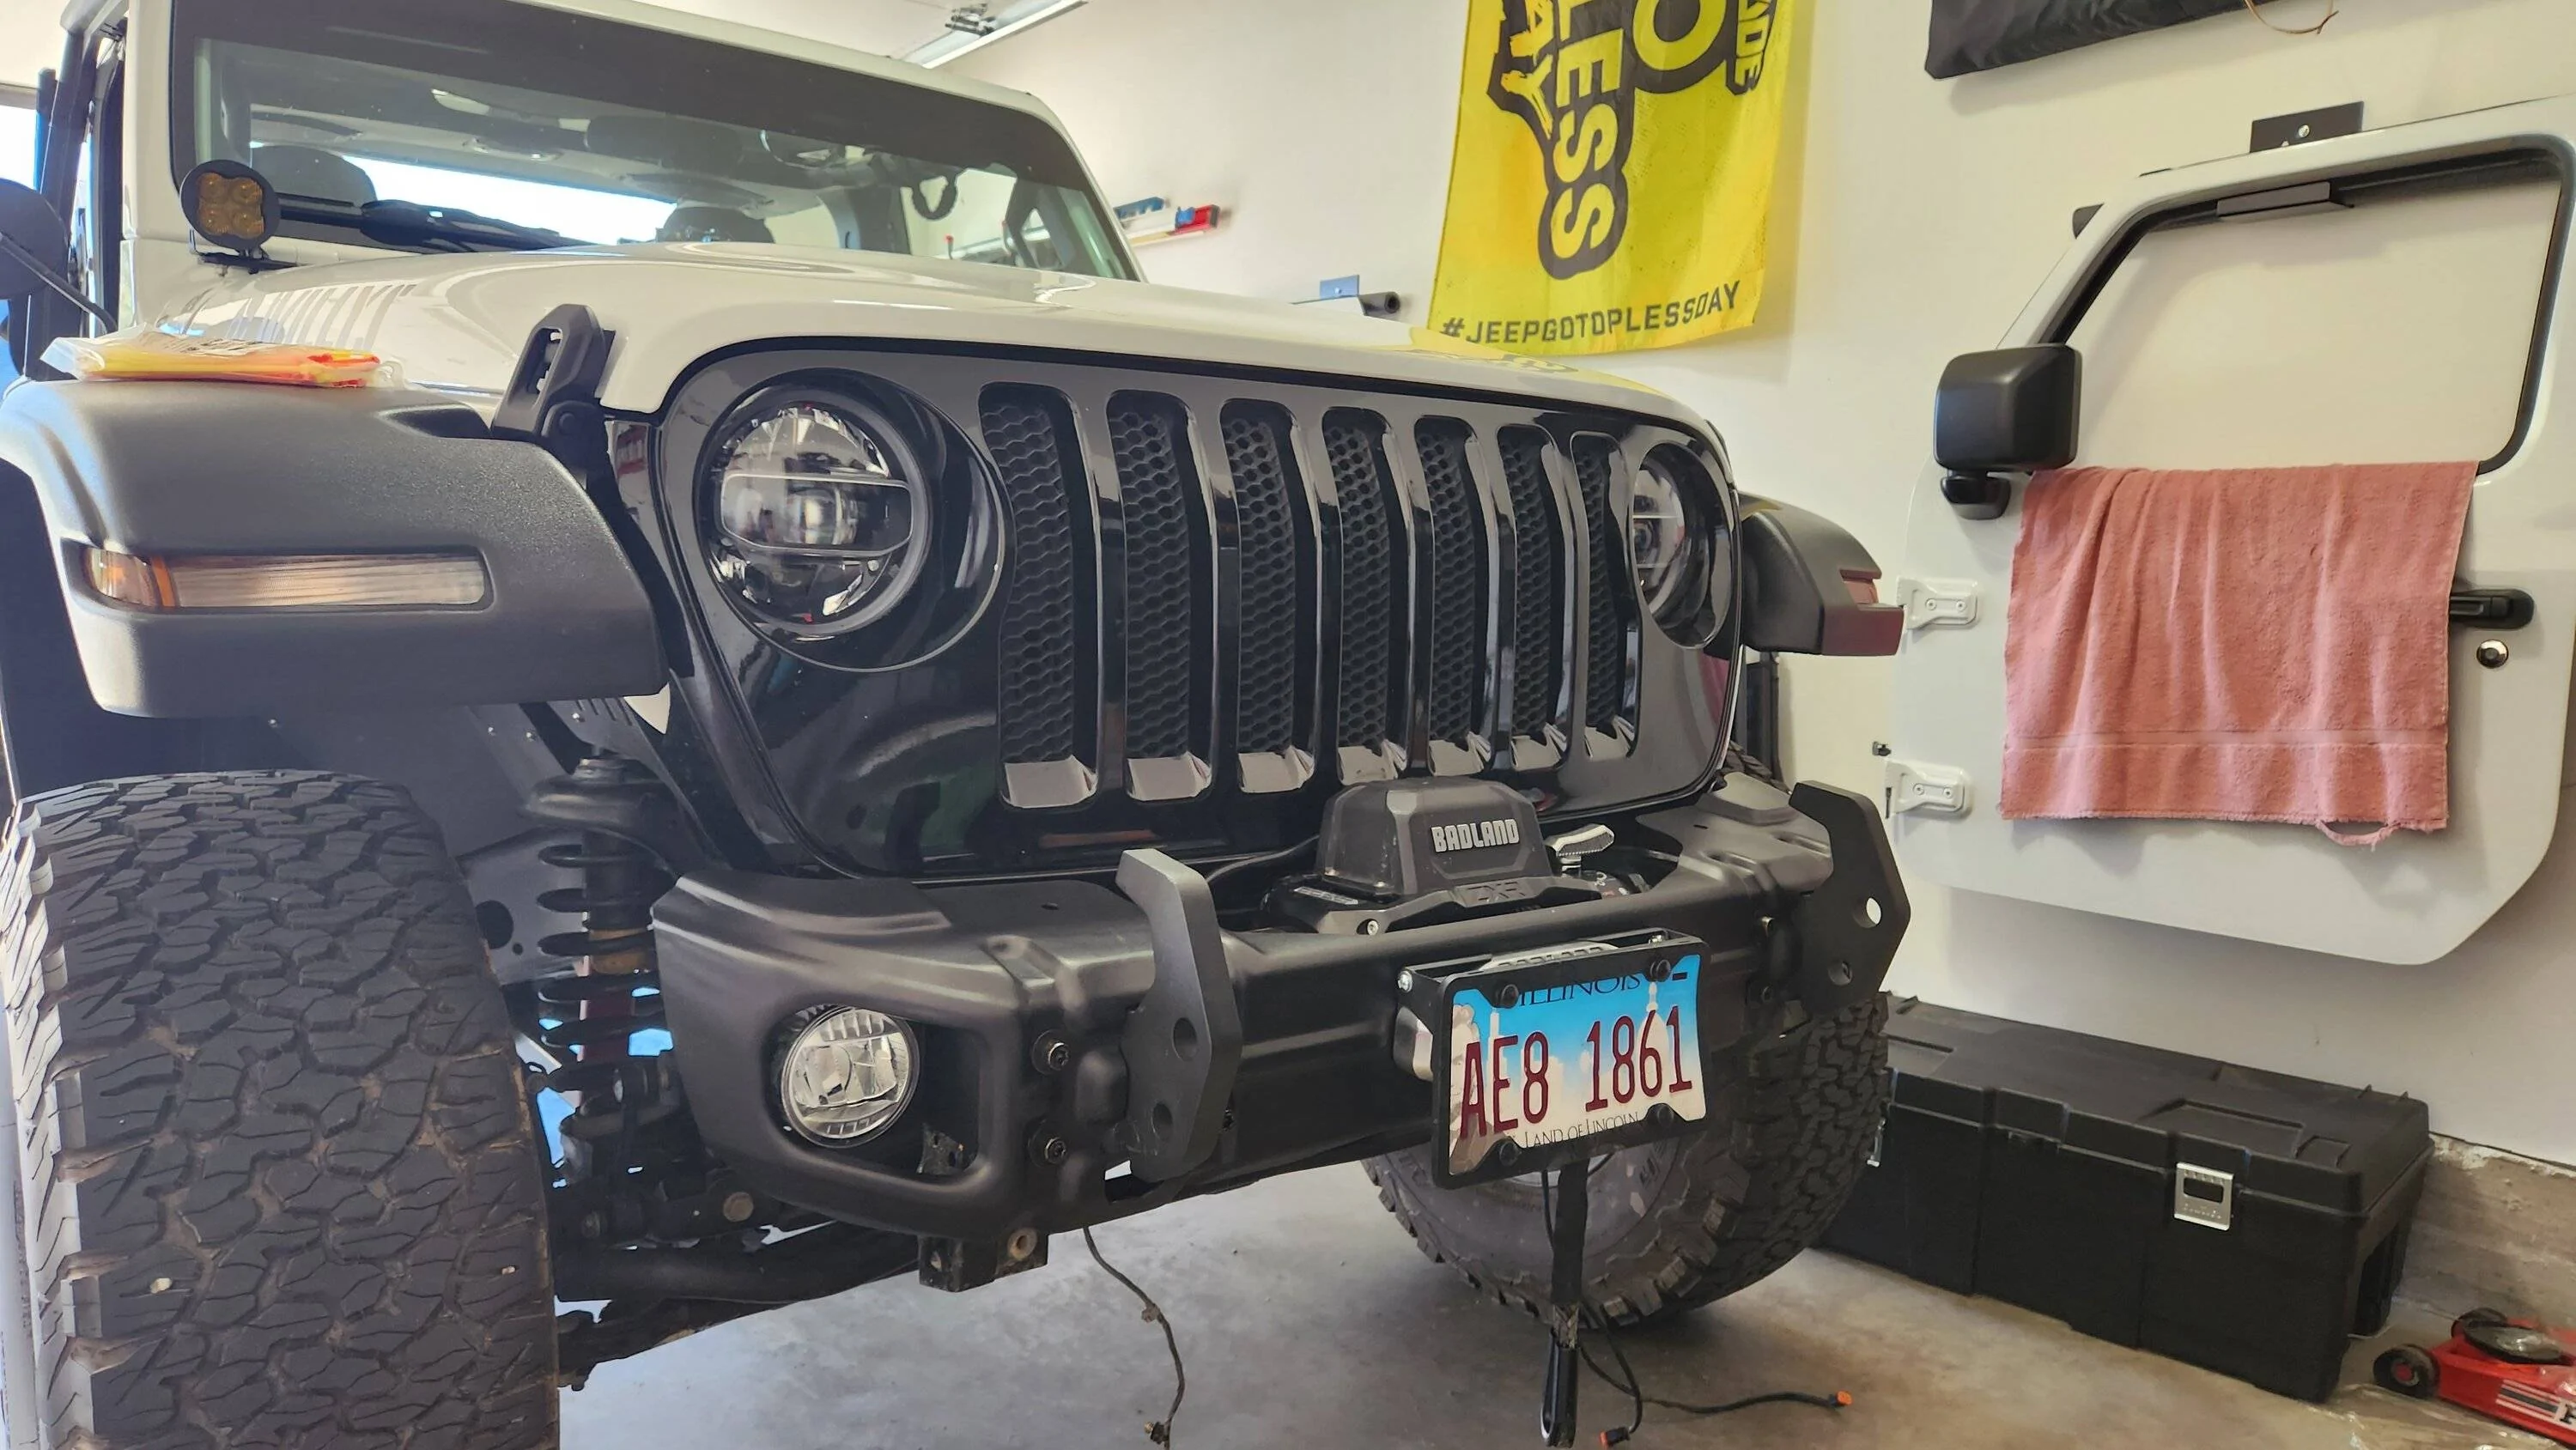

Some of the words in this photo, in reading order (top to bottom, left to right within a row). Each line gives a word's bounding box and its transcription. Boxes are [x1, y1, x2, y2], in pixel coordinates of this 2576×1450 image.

[1442, 281, 1741, 344] #JEEPGOTOPLESSDAY
[1431, 818, 1519, 852] BADLAND
[1461, 1031, 1549, 1140] AE8
[1585, 1005, 1693, 1113] 1861
